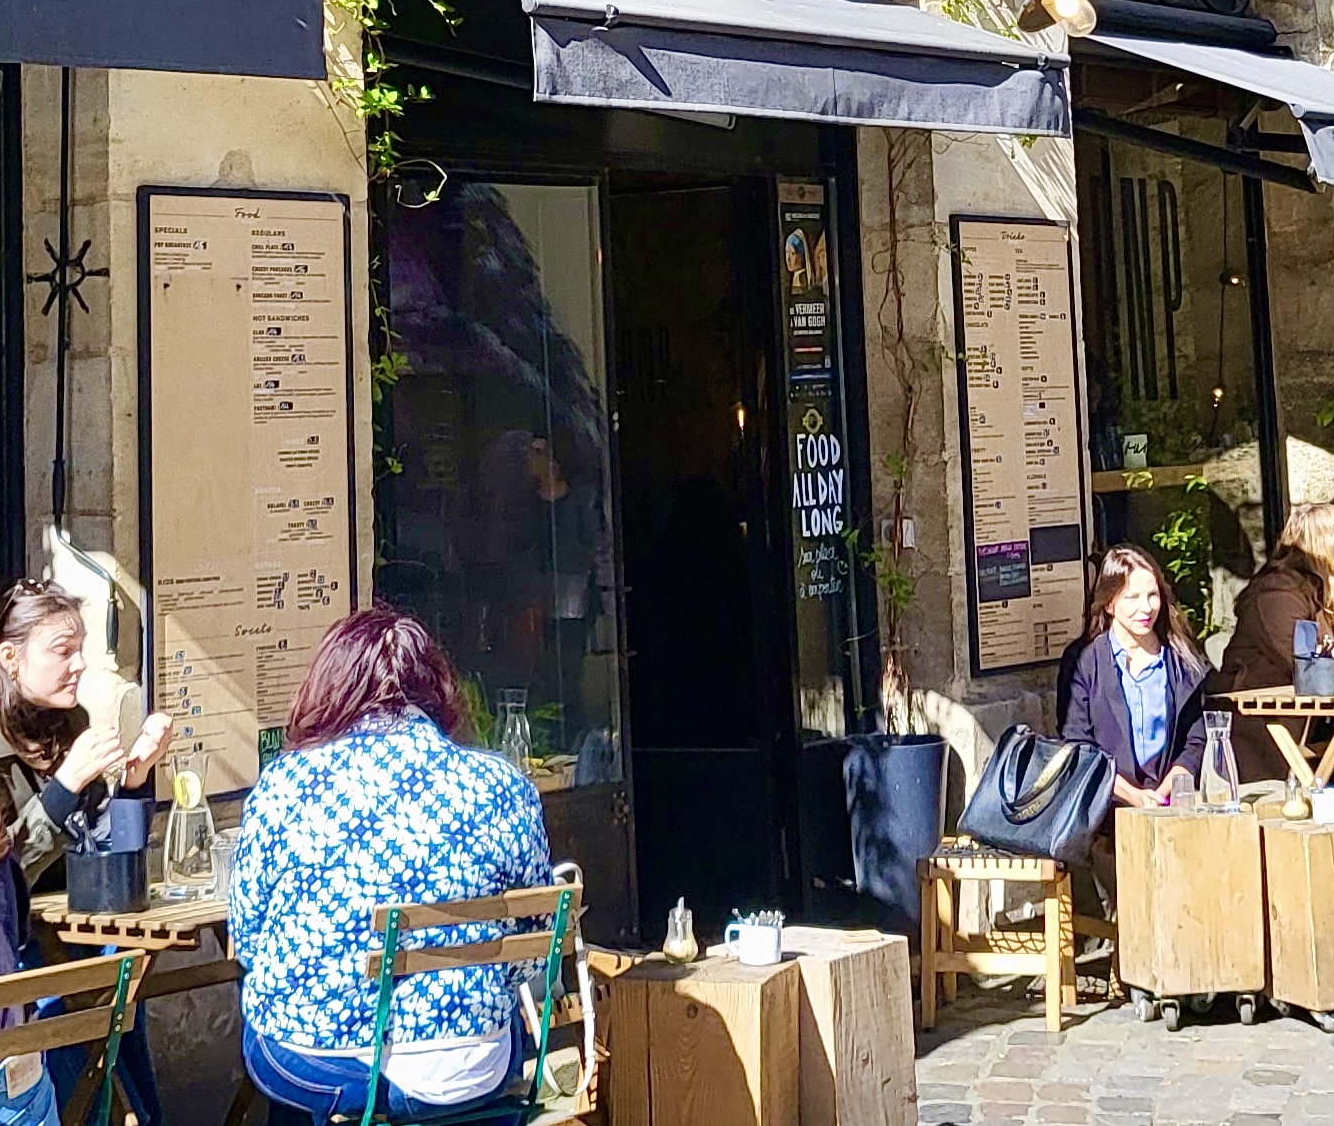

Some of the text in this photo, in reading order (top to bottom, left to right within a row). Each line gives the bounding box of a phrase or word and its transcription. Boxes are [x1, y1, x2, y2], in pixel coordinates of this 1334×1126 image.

[234, 207, 261, 219] Food
[154, 226, 188, 234] SPECIALS
[794, 316, 806, 327] VAN
[796, 433, 841, 470] FOOD
[792, 468, 844, 508] ALL DAY
[801, 505, 844, 538] LONG
[234, 622, 272, 637] Sweets
